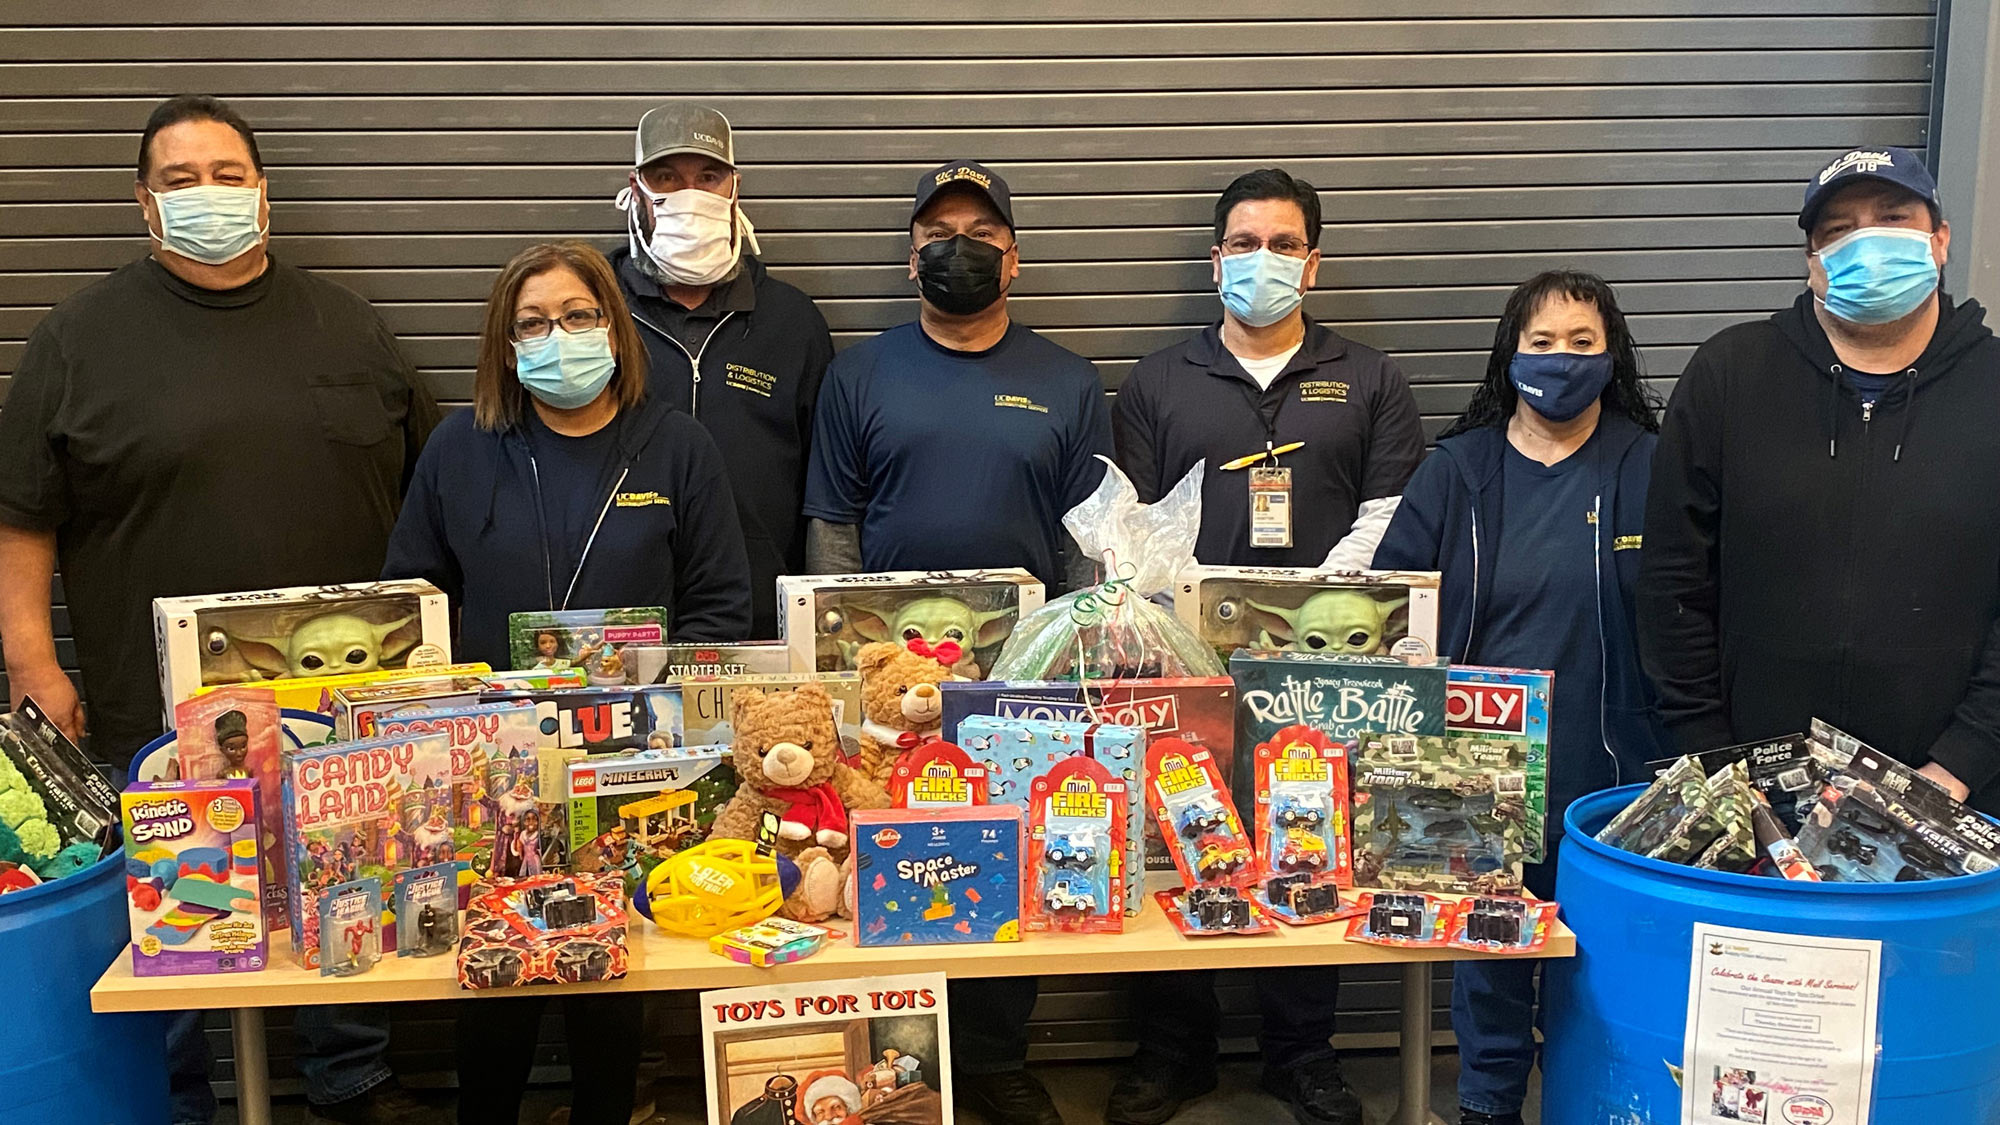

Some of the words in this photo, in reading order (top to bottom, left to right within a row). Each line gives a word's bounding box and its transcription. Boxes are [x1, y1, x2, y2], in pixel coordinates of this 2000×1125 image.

[1844, 151, 1892, 163] Davis
[1857, 161, 1877, 172] 08
[957, 167, 991, 184] Davis
[726, 363, 777, 383] DISTRIBUTION
[735, 373, 772, 390] LOGISTICS
[1300, 381, 1350, 390] DISTRIBUTION
[1309, 388, 1347, 396] LOGISTICS
[669, 664, 721, 676] STARTER
[724, 664, 746, 675] SET
[537, 701, 633, 749] CLUE
[1470, 744, 1509, 754] Military
[1473, 753, 1502, 761] Team
[1753, 743, 1793, 757] Police
[1275, 758, 1327, 773] FIRE
[1756, 751, 1792, 765] Force
[299, 743, 413, 791] CANDY
[1157, 763, 1202, 788] FIRE
[1374, 767, 1413, 778] Military
[574, 776, 594, 786] LEGO
[601, 767, 679, 786] MINECRAFT
[914, 777, 967, 793] FIRE
[1276, 772, 1328, 781] TRUCKS
[1363, 772, 1405, 788] Troop
[85, 780, 111, 807] Force
[88, 773, 117, 803] Police
[1163, 777, 1206, 797] TRUCKS
[301, 782, 388, 825] LAND
[914, 791, 967, 801] TRUCKS
[1052, 791, 1106, 808] FIRE
[131, 800, 188, 821] Kinetic
[213, 799, 223, 811] 3
[1053, 806, 1107, 818] TRUCKS
[932, 827, 946, 836] 3+
[982, 829, 996, 839] 74
[1888, 802, 1919, 829] City
[1915, 820, 1965, 854] Traffic
[1955, 822, 1996, 851] Force
[897, 855, 953, 884] Space
[923, 864, 977, 888] Master
[1711, 966, 1744, 980] Celebrate
[1747, 972, 1758, 981] the
[1761, 974, 1785, 985] Season
[1787, 978, 1801, 986] with
[1804, 978, 1822, 988] Mail
[712, 998, 785, 1023] TOYS
[794, 994, 860, 1017] FOR
[867, 988, 937, 1011] TOTS
